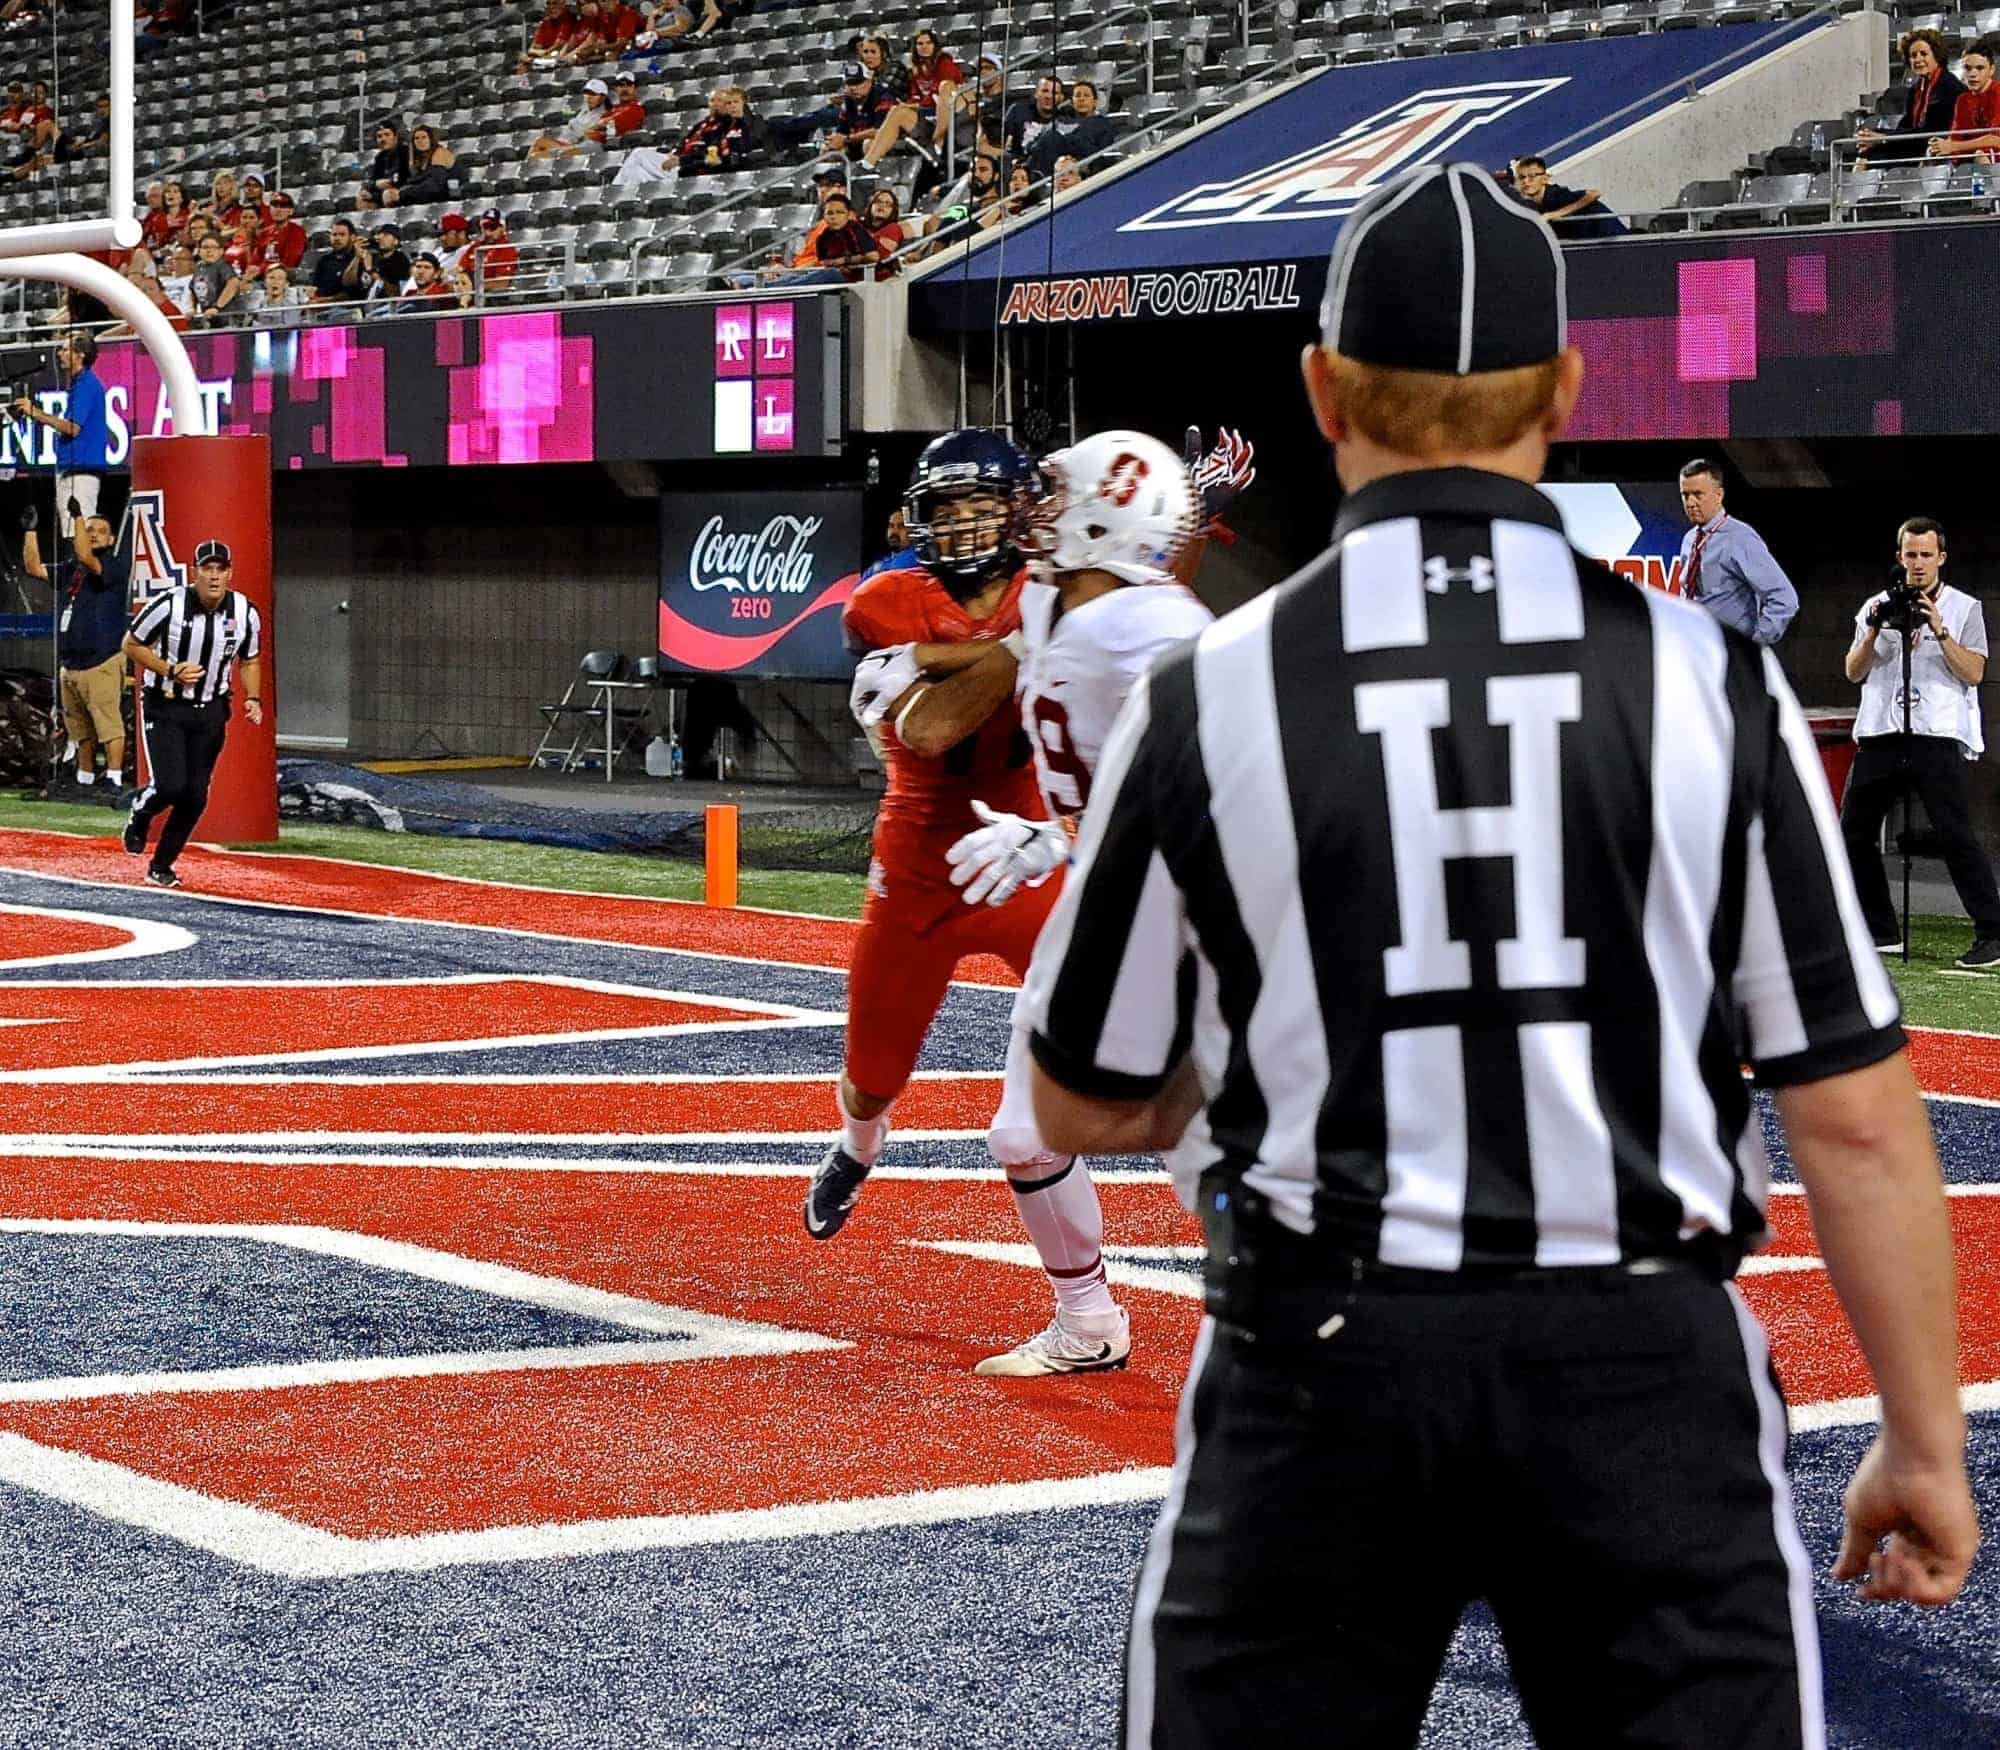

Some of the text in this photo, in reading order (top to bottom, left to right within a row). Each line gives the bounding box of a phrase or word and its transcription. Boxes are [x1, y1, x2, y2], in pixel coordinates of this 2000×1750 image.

[723, 319, 786, 361] R L
[763, 396, 786, 434] L
[690, 515, 823, 593] Coca-Cola
[731, 597, 772, 619] zero
[1354, 671, 1587, 998] H
